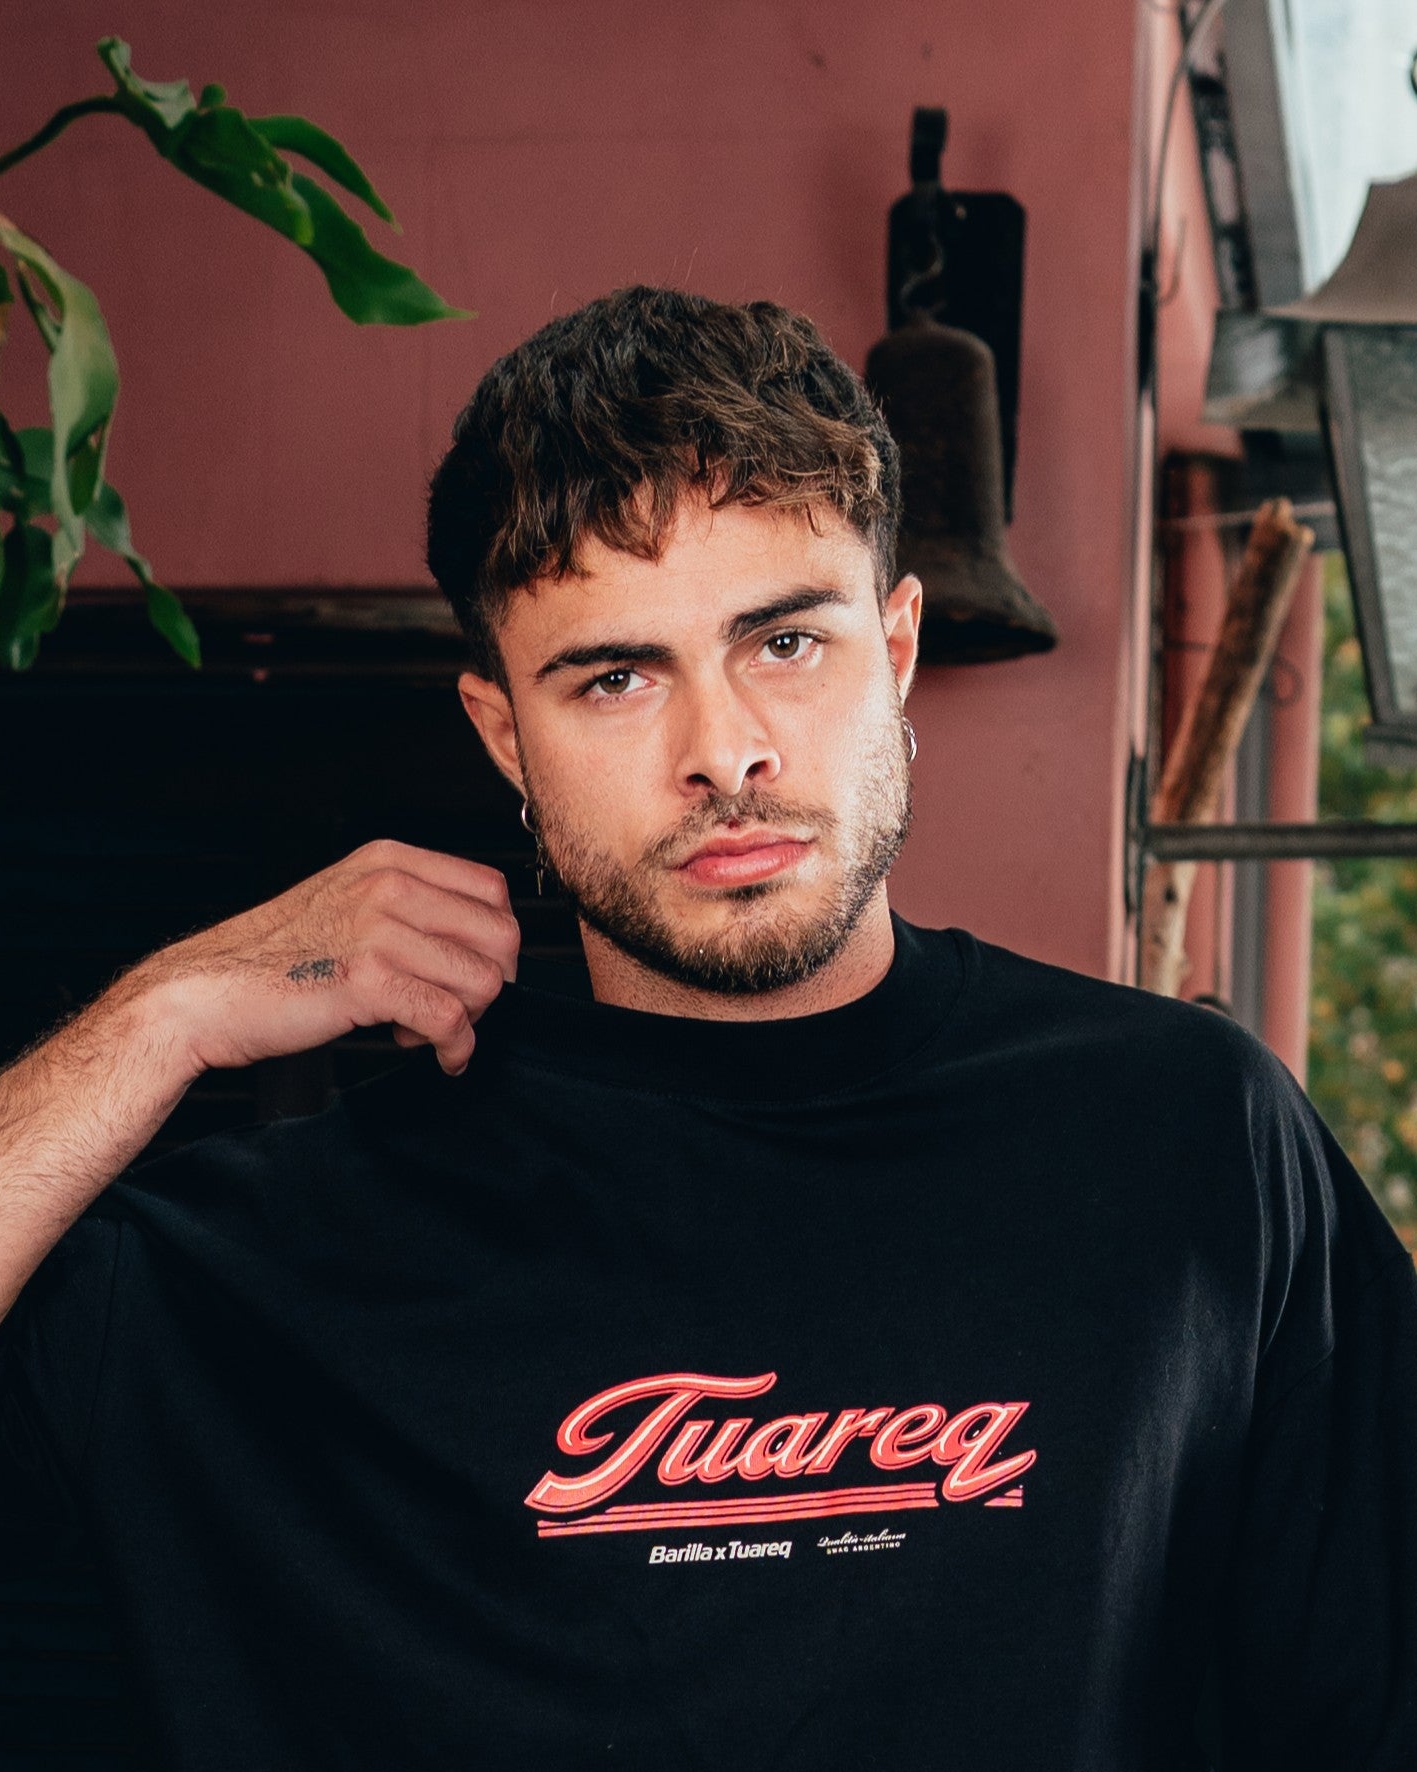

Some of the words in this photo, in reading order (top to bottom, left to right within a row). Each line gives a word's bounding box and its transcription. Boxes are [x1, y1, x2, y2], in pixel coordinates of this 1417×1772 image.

[648, 1542, 713, 1564] Barilla
[713, 1546, 728, 1560] x
[727, 1540, 793, 1560] Tuareq
